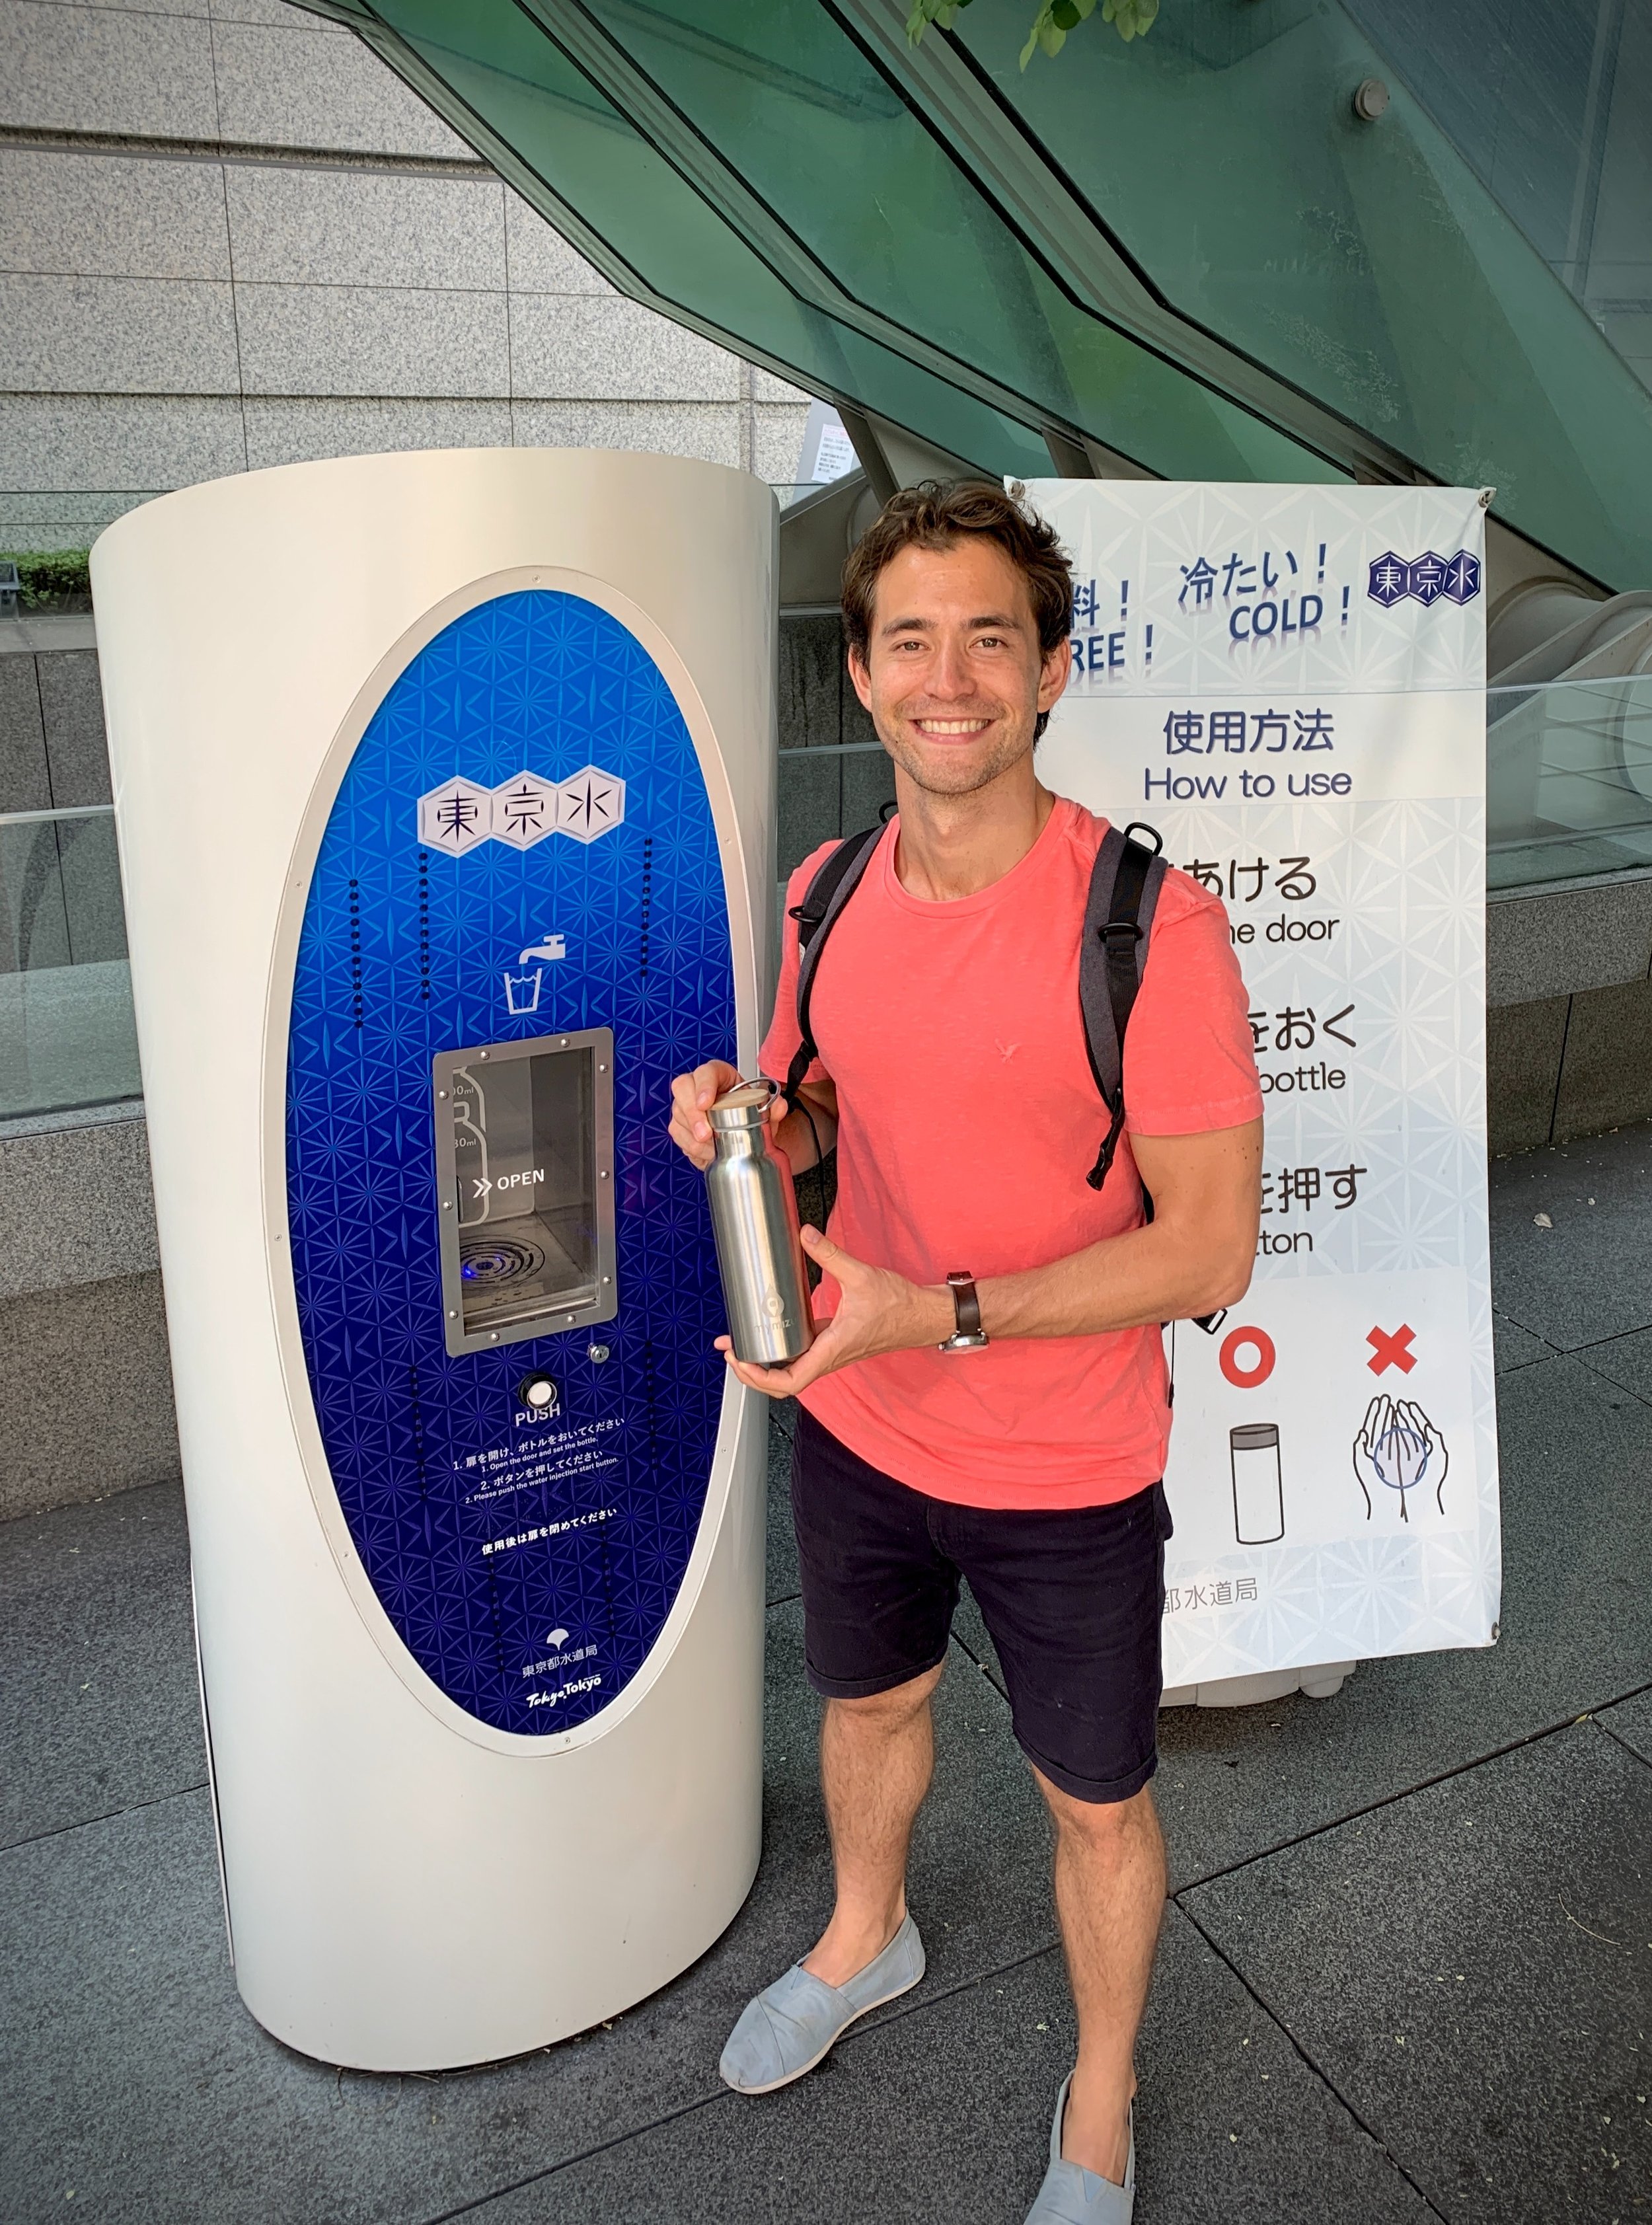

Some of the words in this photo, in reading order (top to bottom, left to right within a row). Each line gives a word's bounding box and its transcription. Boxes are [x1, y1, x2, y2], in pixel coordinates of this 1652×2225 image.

[1178, 543, 1327, 604] 冷たい！
[1374, 557, 1476, 598] 東京水
[1163, 708, 1334, 755] 使用方法
[1145, 767, 1227, 801] How
[1240, 770, 1275, 798] to
[1287, 771, 1353, 796] use
[437, 776, 613, 844] 東京水
[1168, 856, 1316, 902] あける
[1266, 913, 1340, 943] door
[497, 1168, 544, 1190] OPEN
[1256, 1230, 1314, 1256] ton
[515, 1403, 560, 1427] PUSH
[453, 1460, 463, 1470] 1.
[490, 1462, 508, 1470] Open
[522, 1453, 537, 1462] door
[539, 1448, 551, 1456] and
[577, 1437, 598, 1447] bottle.
[474, 1490, 497, 1501] Please
[498, 1486, 515, 1495] push
[529, 1476, 548, 1487] water
[549, 1468, 578, 1480] injection
[579, 1463, 594, 1472] start
[595, 1457, 619, 1468] button.
[480, 1481, 490, 1491] 2.
[482, 1508, 617, 1556] 使用後は扉を閉めてください
[522, 1644, 597, 1678] 東京都水道局
